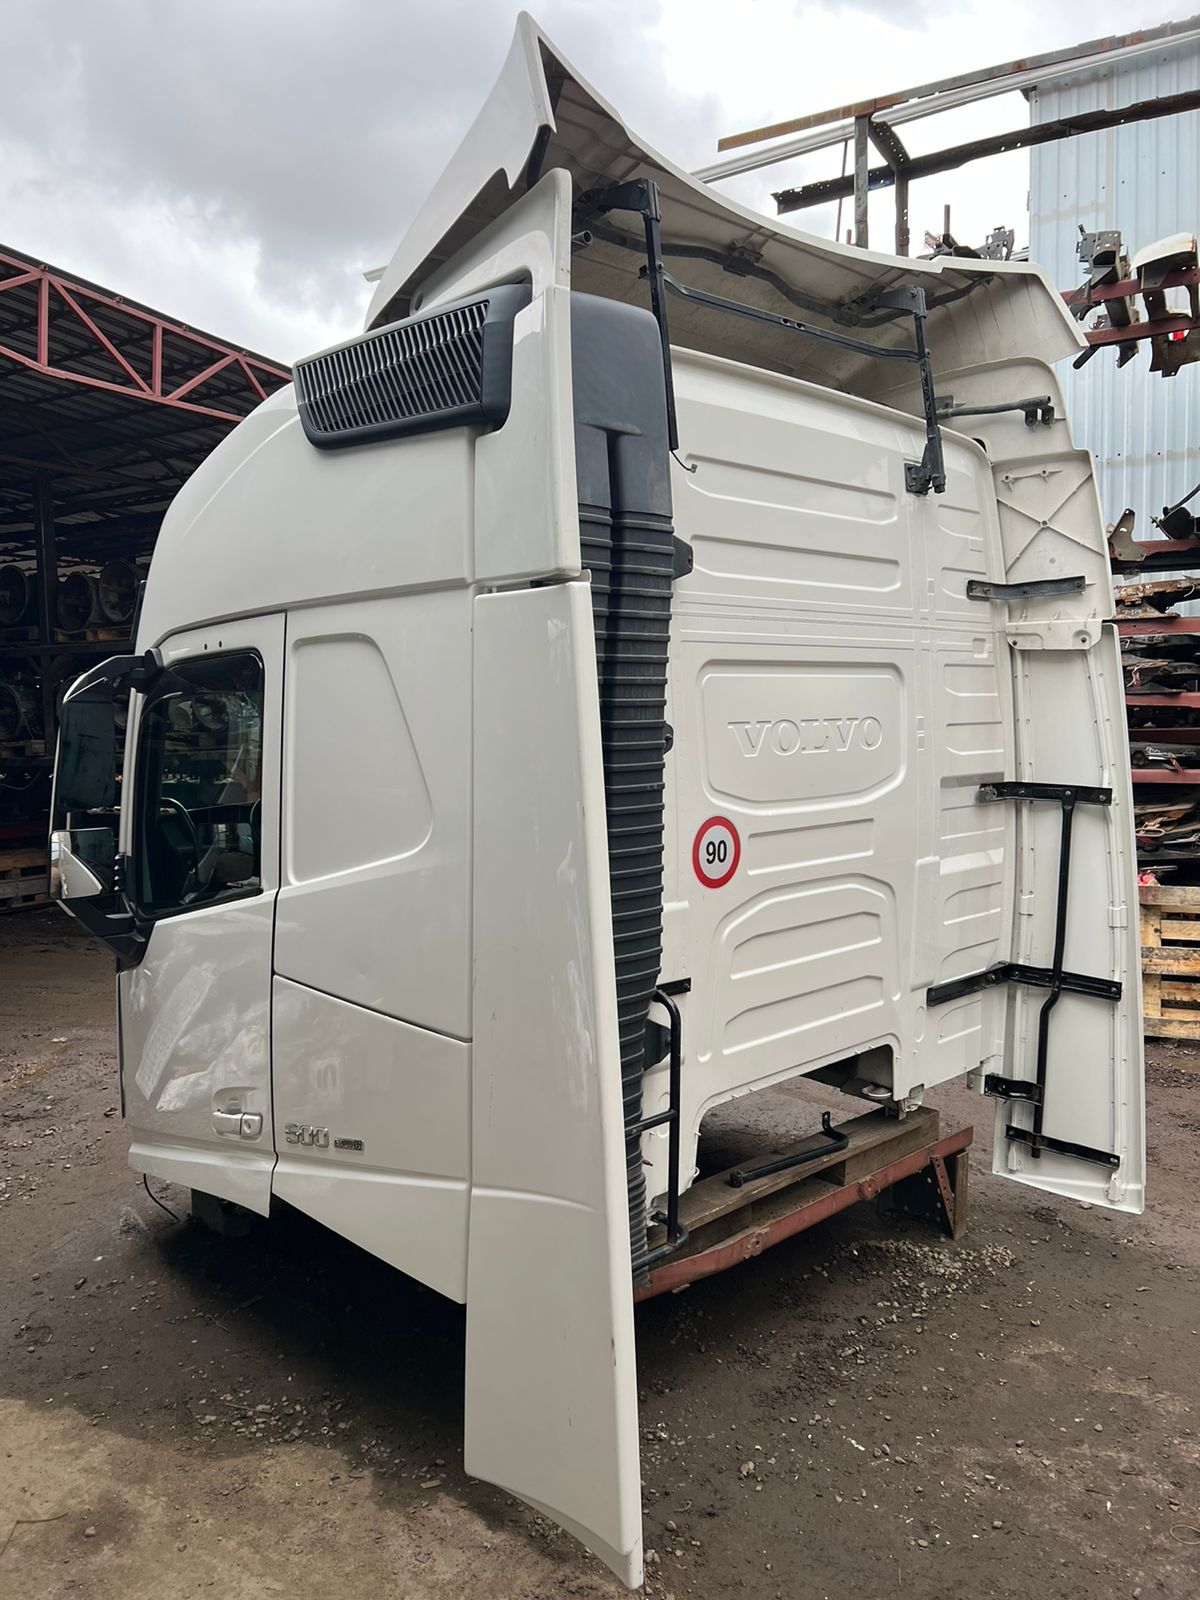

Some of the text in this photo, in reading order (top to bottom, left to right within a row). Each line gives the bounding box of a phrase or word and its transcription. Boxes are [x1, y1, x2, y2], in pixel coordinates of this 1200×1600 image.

[727, 716, 883, 757] VOLVO
[706, 839, 727, 864] 90
[285, 1122, 329, 1148] 500
